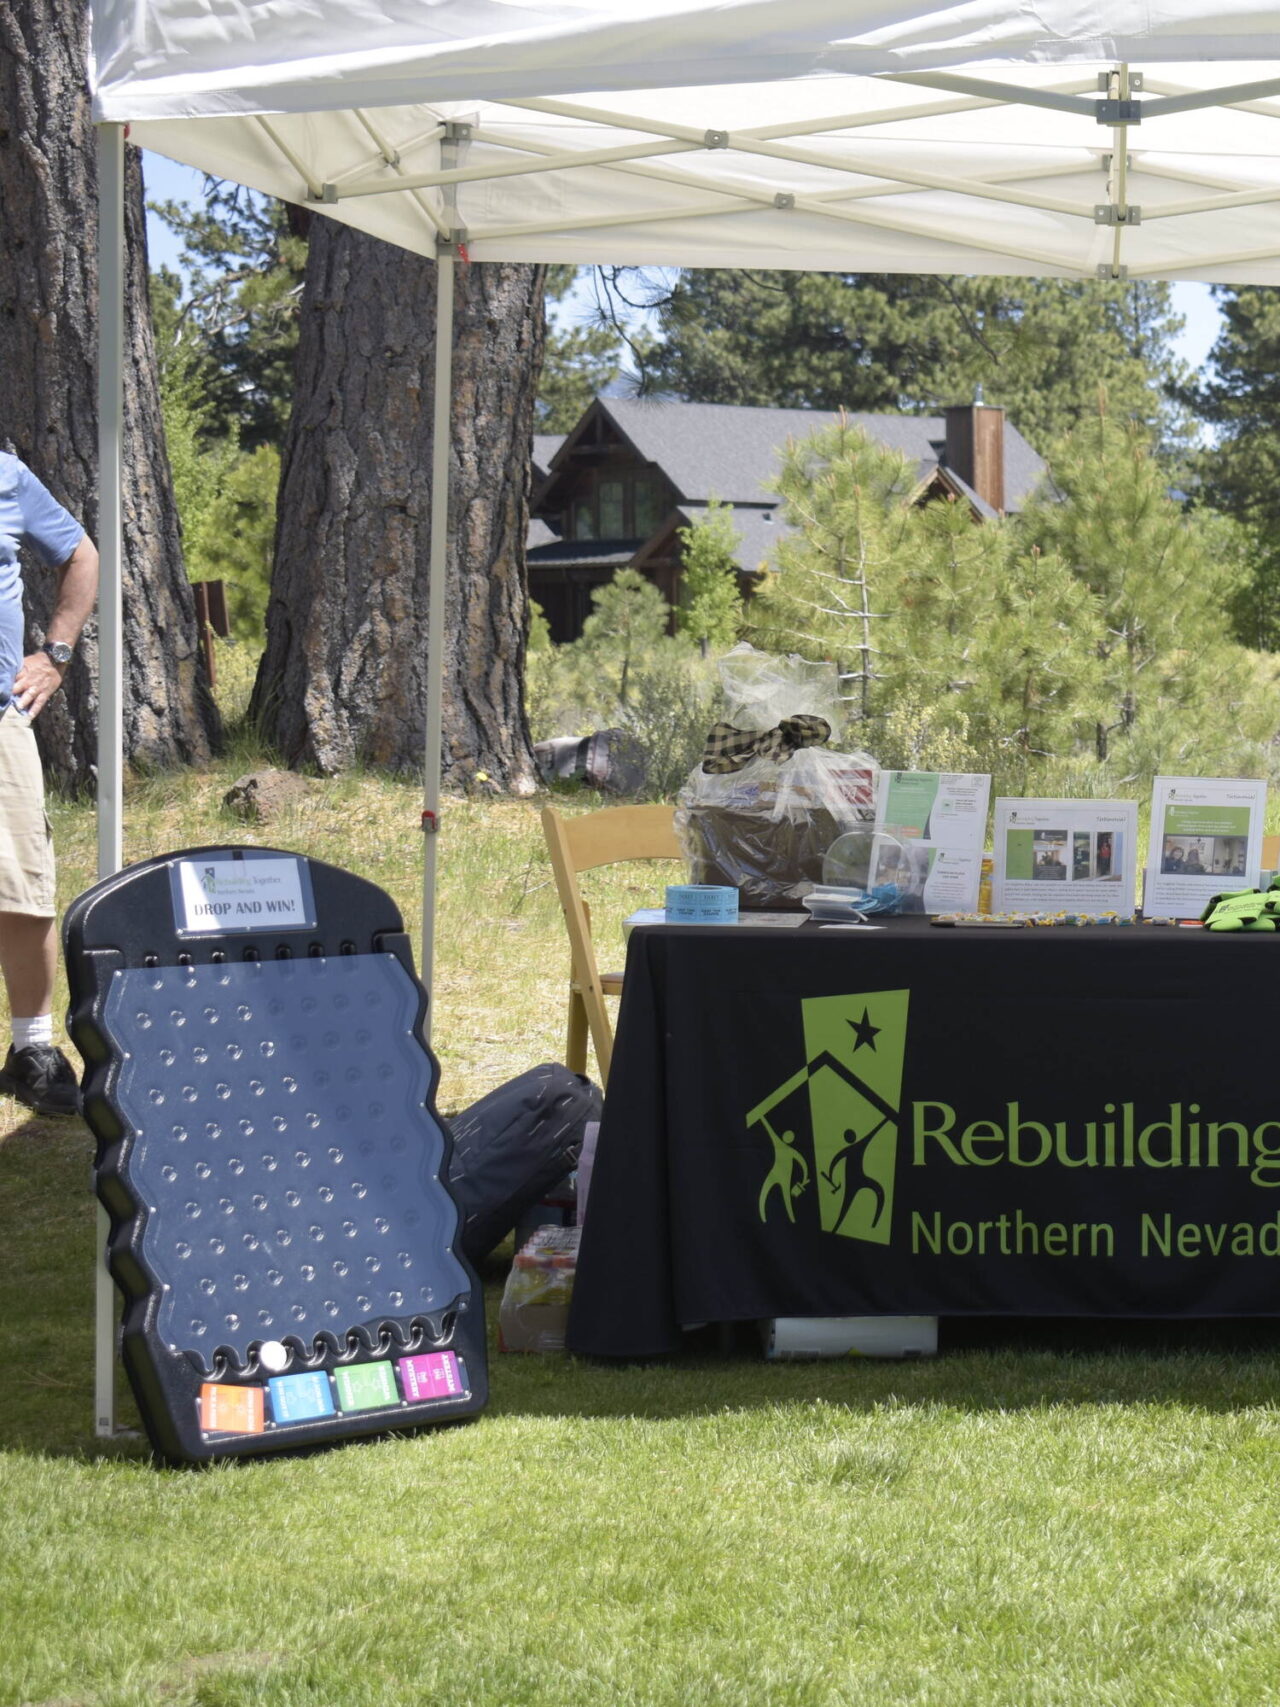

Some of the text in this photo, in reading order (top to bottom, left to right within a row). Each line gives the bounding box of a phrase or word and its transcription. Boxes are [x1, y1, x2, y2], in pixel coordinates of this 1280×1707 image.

[194, 899, 296, 916] DROP AND WIN!
[912, 1208, 1115, 1258] Northern
